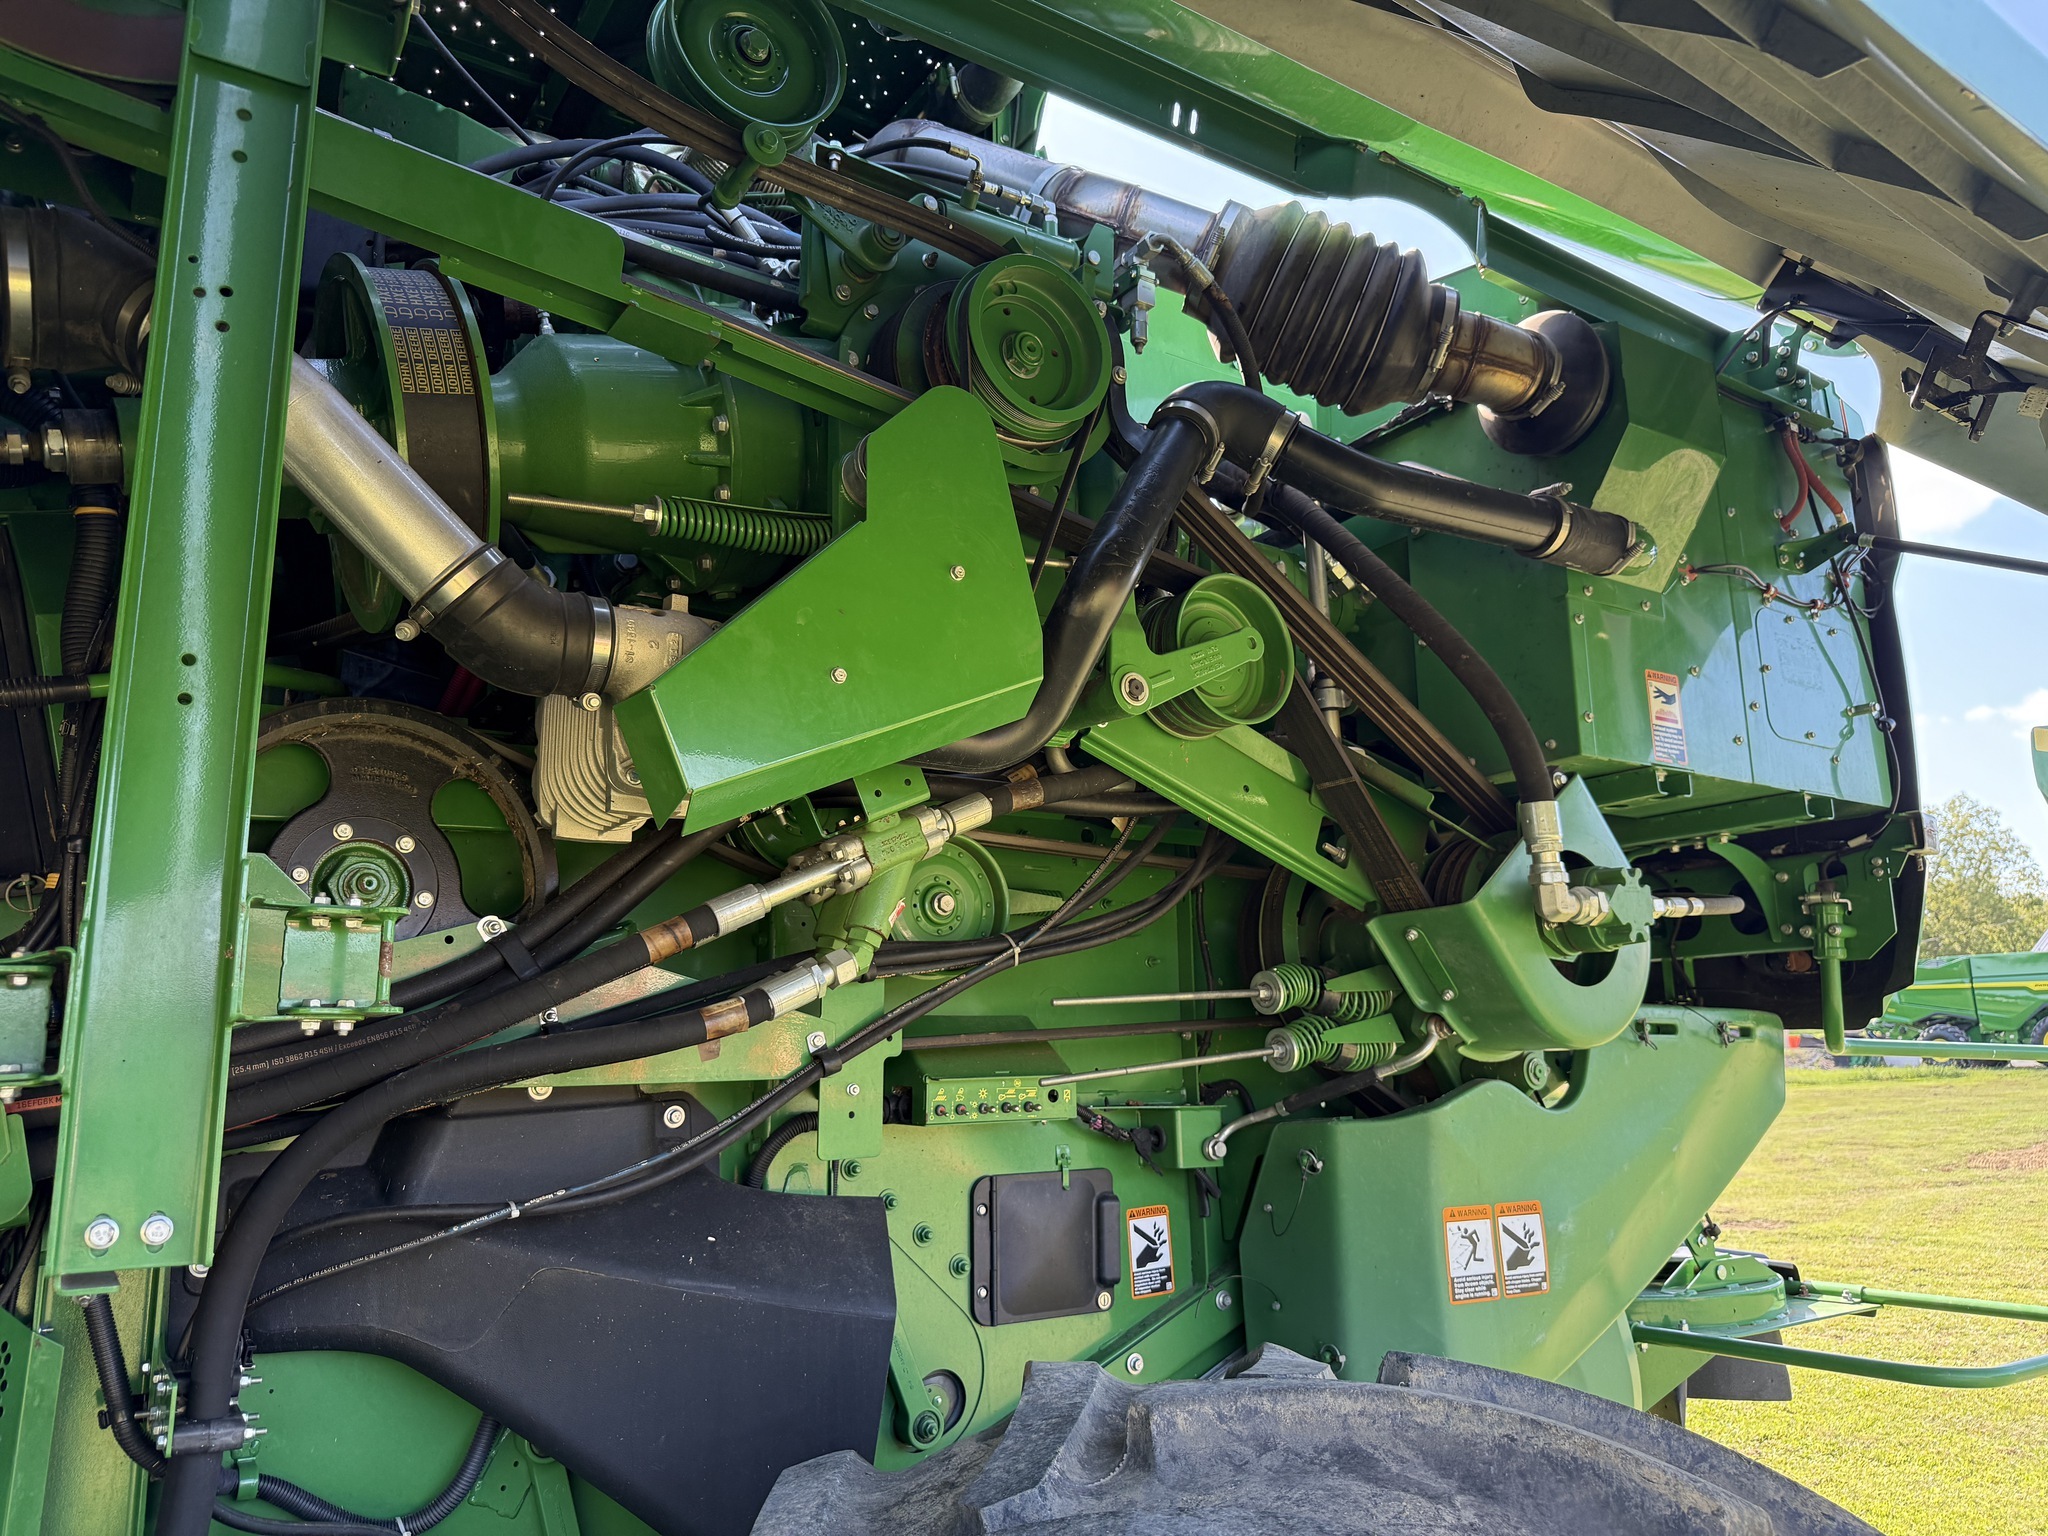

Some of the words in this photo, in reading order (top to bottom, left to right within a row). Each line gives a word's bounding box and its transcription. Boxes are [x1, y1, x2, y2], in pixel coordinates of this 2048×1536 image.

[392, 328, 407, 358] DEERE
[407, 329, 422, 359] DEERE
[422, 329, 437, 360] DEERE
[438, 330, 453, 360] DEERE
[454, 331, 468, 361] DEERE
[400, 362, 413, 391] JOHN
[415, 363, 428, 391] JOHN
[431, 364, 444, 392] JOHN
[446, 364, 459, 392] JOHN
[461, 365, 474, 392] JOHN
[1653, 673, 1677, 683] WARNING
[252, 1060, 269, 1071] mm]
[271, 1057, 285, 1066] ISO
[285, 1053, 304, 1063] 3862
[304, 1050, 319, 1060] R15
[319, 1045, 334, 1056] 4SH
[338, 1038, 367, 1051] Exceeds
[366, 1030, 389, 1044] EN856
[389, 1027, 403, 1037] R15
[1135, 1206, 1166, 1217] WARNING
[1457, 1208, 1487, 1217] WARNING
[1505, 1203, 1537, 1213] WARNING
